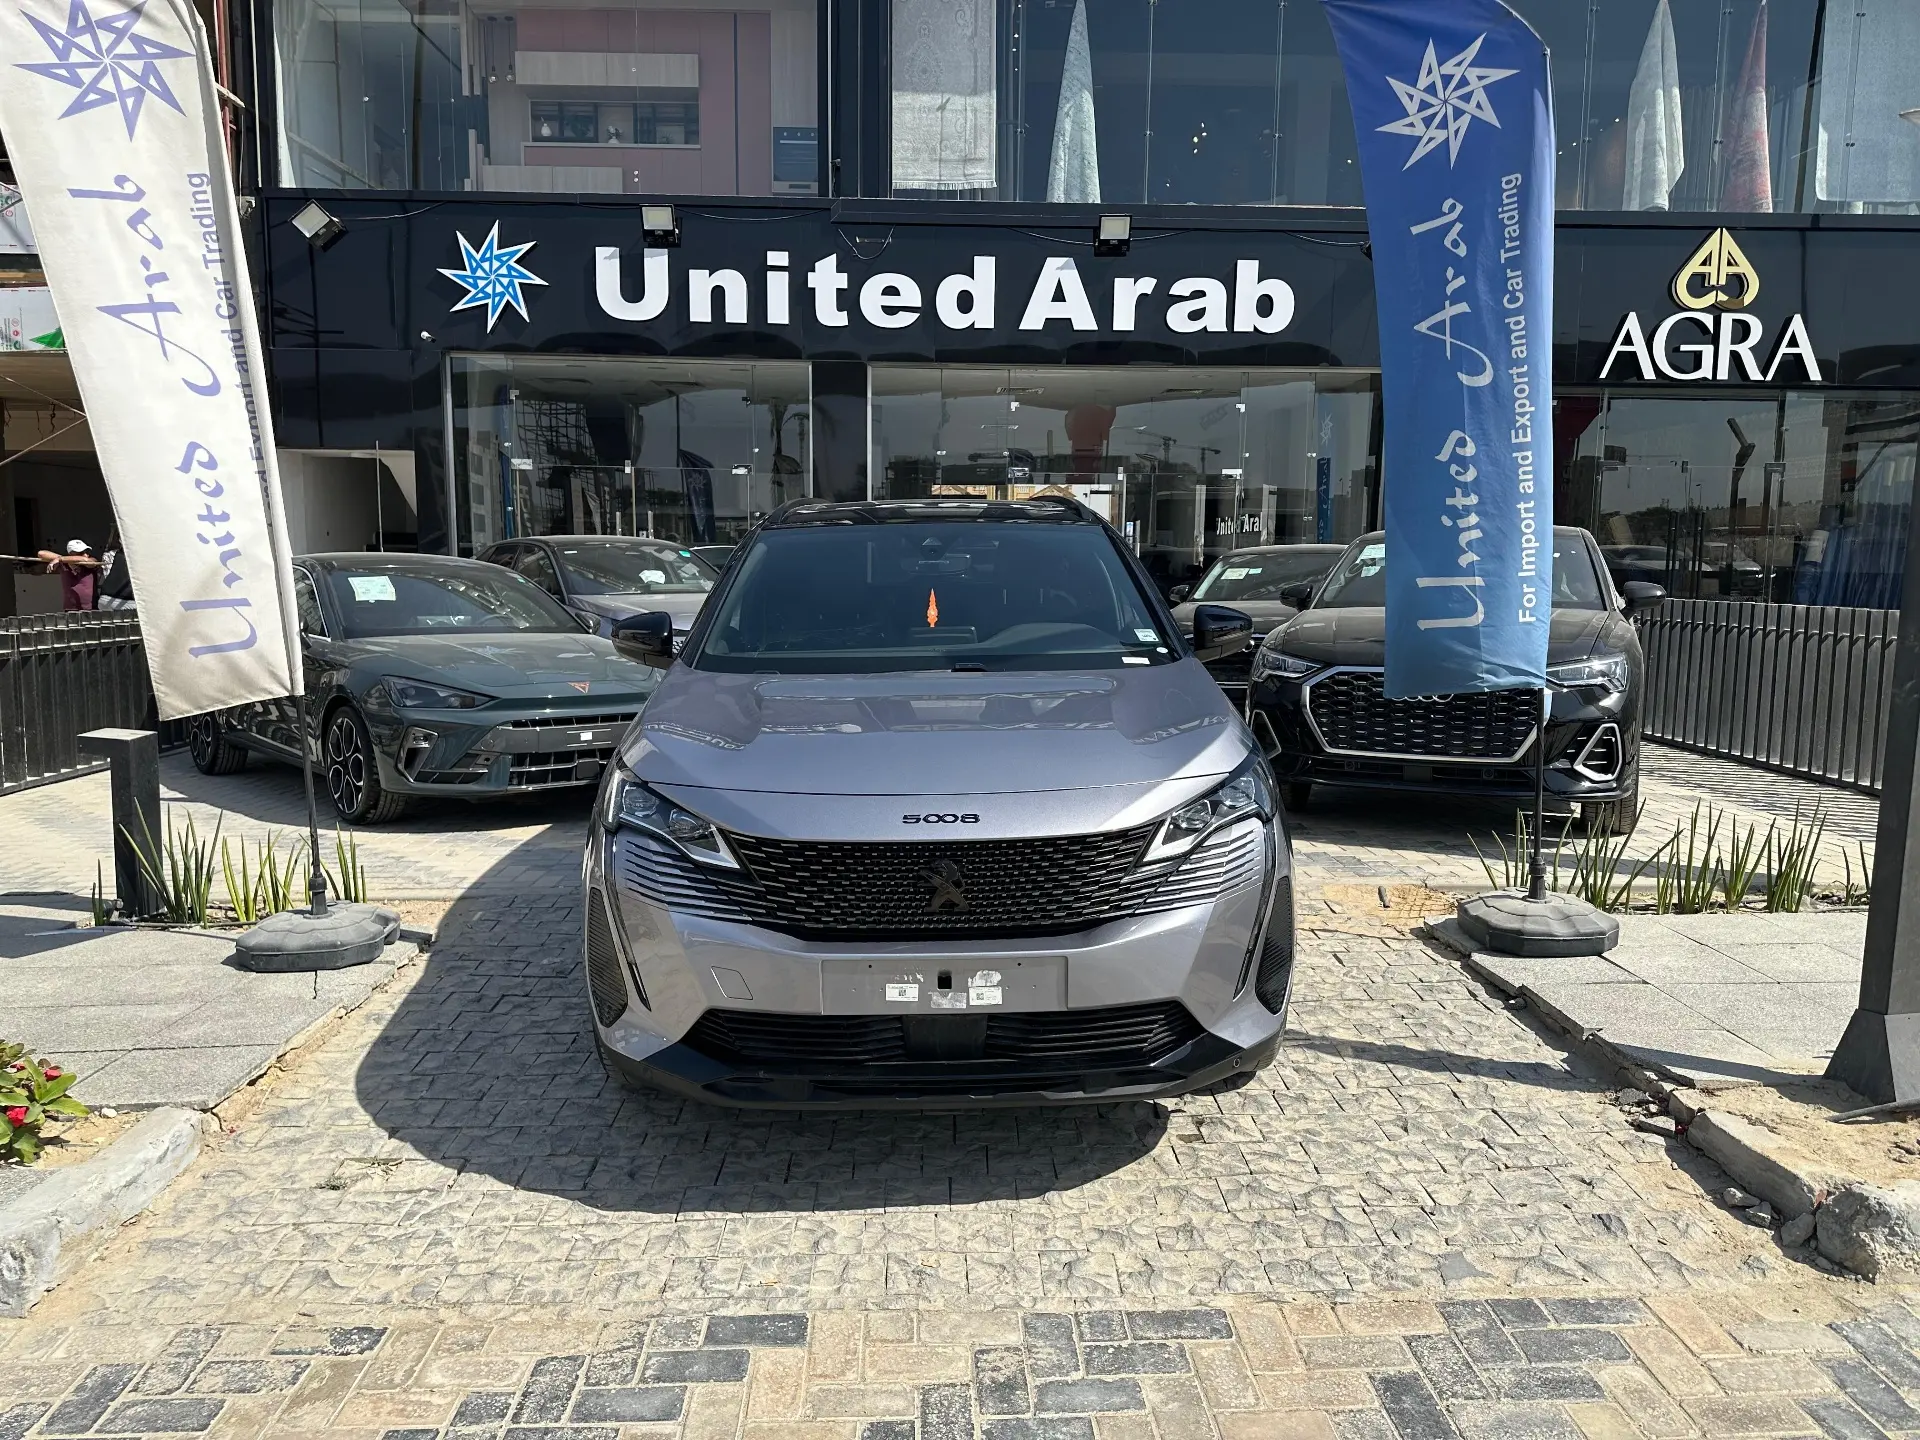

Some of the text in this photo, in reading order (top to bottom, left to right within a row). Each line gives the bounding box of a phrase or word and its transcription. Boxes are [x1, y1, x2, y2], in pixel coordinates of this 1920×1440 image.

[187, 172, 226, 270] Trading
[67, 174, 222, 397] Arab
[213, 276, 238, 320] Car
[595, 246, 1295, 334] United Arab
[1409, 197, 1494, 387] Arab
[1599, 311, 1822, 381] AGRA
[1498, 172, 1540, 624] For Import and Export and Car Trading
[902, 813, 980, 824] 5008
